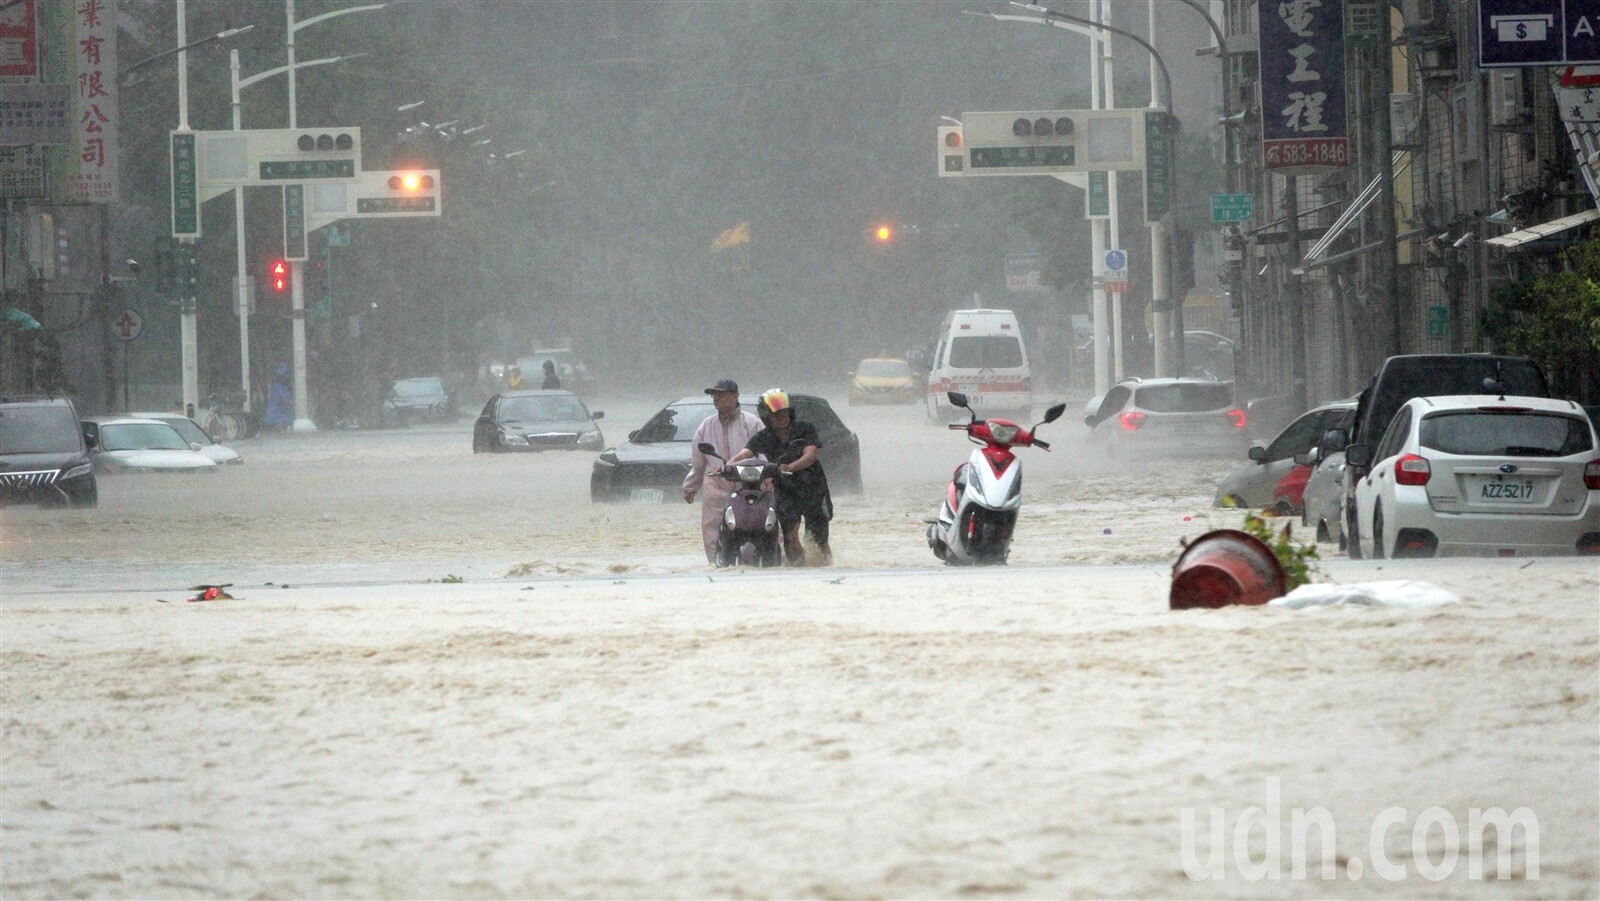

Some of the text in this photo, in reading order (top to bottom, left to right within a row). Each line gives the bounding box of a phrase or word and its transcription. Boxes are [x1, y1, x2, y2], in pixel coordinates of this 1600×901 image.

[1572, 15, 1600, 37] A
[1278, 0, 1329, 132] 電工程
[77, 0, 111, 168] 業有限公司
[1283, 143, 1346, 162] 583-1846
[1481, 483, 1533, 499] AZZ-5217
